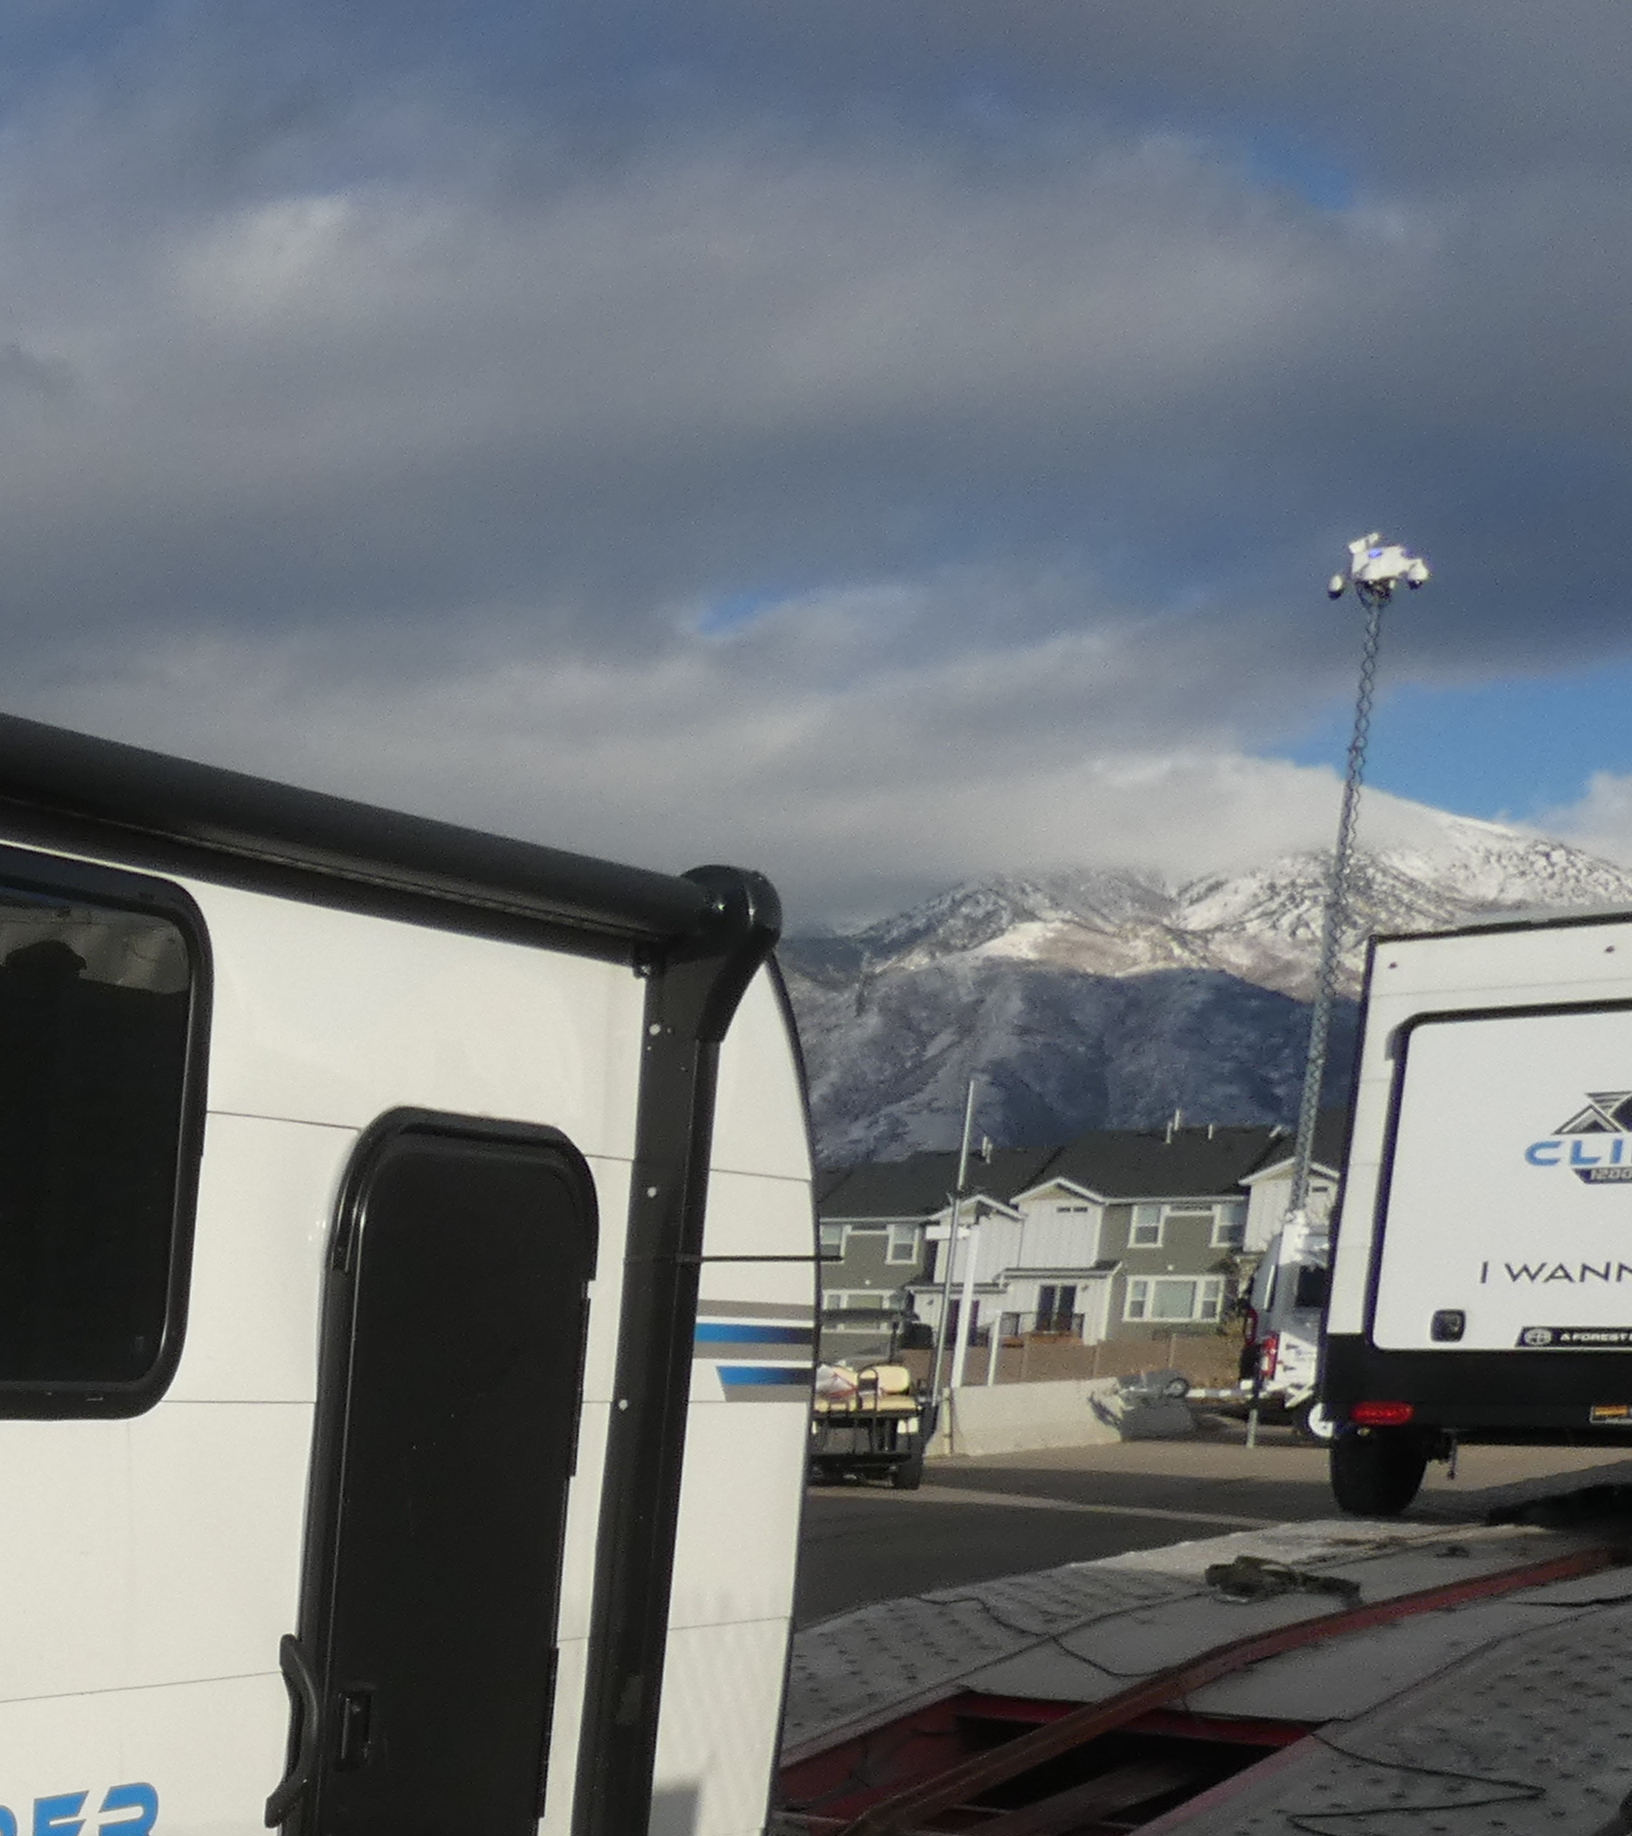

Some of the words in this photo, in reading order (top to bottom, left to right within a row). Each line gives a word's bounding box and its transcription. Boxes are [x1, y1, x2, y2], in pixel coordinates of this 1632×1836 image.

[1524, 1138, 1632, 1166] CLI
[1480, 1261, 1488, 1283] I
[1505, 1261, 1632, 1283] WANN
